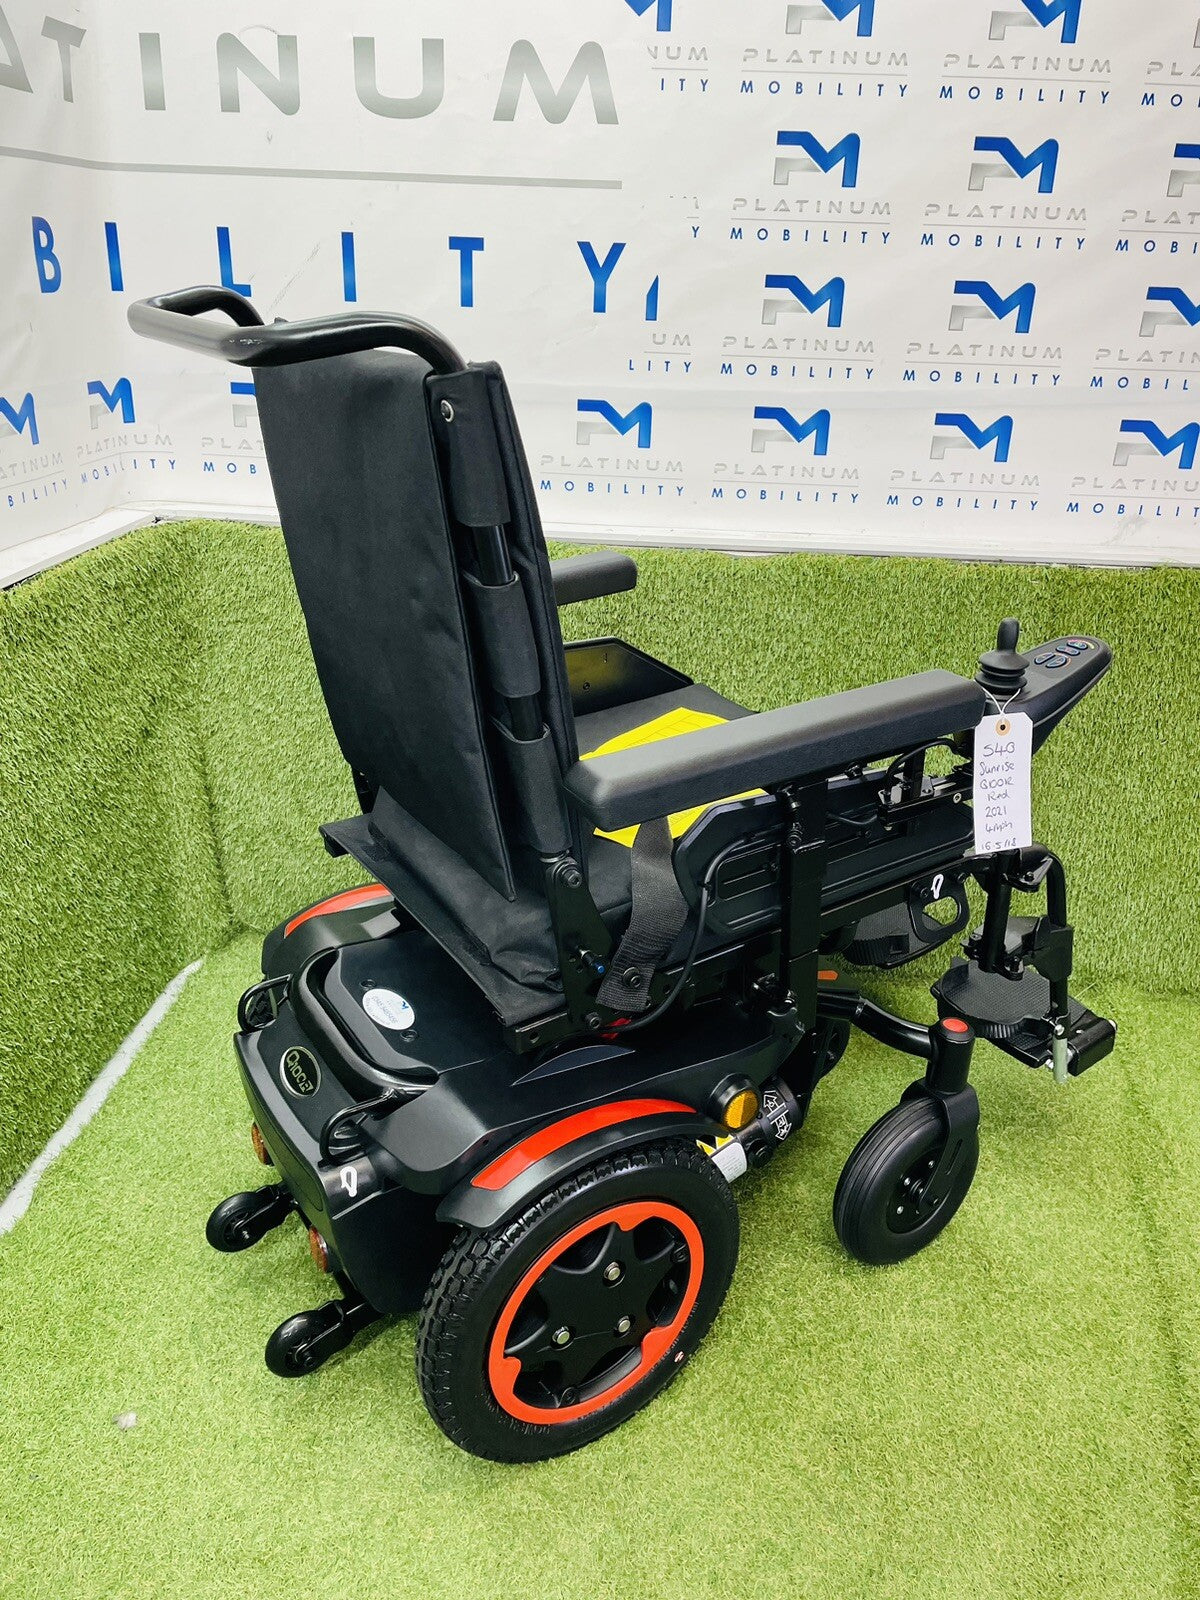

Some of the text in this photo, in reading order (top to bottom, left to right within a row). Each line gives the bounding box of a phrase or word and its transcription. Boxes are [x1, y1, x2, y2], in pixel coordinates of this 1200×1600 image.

[743, 48, 909, 66] PLATINUM
[944, 54, 1111, 73] PLATINUM
[740, 80, 908, 97] MOBILITY
[938, 85, 1110, 104] MOBILITY
[732, 198, 891, 216] PLATINUM
[924, 203, 1087, 221] PLATINUM
[729, 227, 890, 244] MOBILITY
[920, 234, 1086, 250] MOBILITY
[723, 336, 874, 353] PLATINUM
[907, 343, 1062, 360] PLATINUM
[720, 363, 874, 380] MOBILITY
[903, 370, 1060, 386] MOBILITY
[77, 434, 173, 458] PLATINUM
[81, 459, 176, 483] MOBILITY
[540, 455, 684, 473] PLATINUM
[713, 463, 859, 480] PLATINUM
[890, 470, 1040, 486] PLATINUM
[540, 480, 684, 496] MOBILITY
[711, 487, 859, 503] MOBILITY
[886, 495, 1039, 511] MOBILITY
[980, 762, 1014, 776] Sunrise
[985, 806, 1007, 818] 2021
